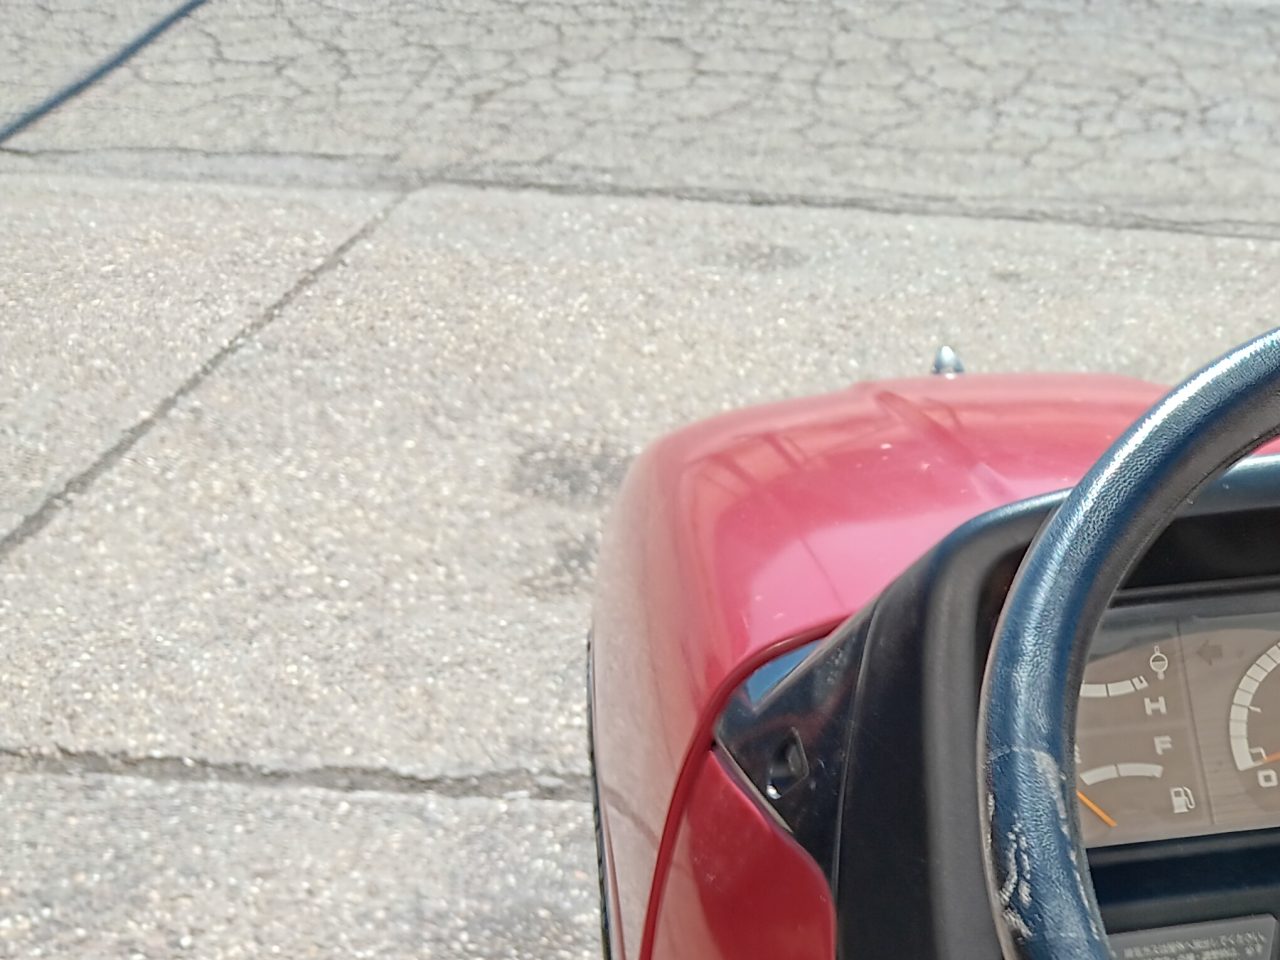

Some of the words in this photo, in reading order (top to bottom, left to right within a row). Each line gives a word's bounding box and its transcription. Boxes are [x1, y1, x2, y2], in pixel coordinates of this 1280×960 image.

[1143, 695, 1167, 716] H
[1153, 735, 1172, 755] F
[1257, 769, 1278, 788] 0
